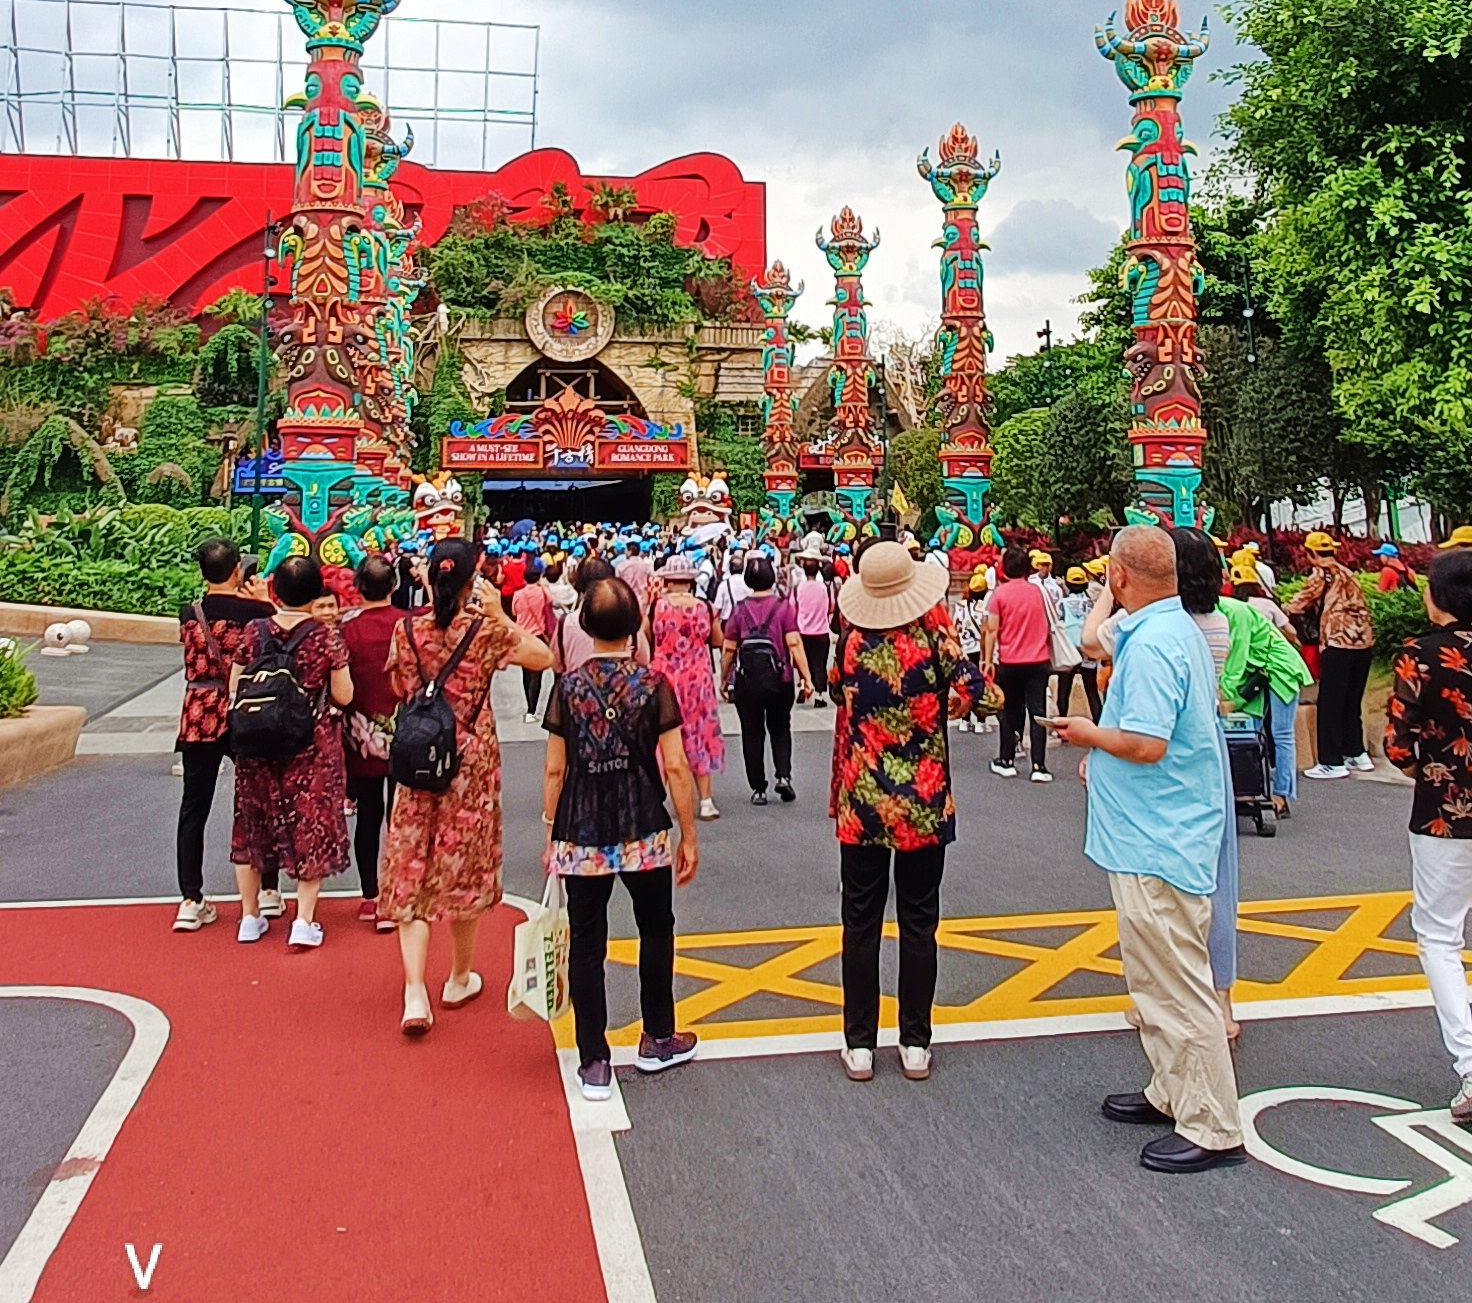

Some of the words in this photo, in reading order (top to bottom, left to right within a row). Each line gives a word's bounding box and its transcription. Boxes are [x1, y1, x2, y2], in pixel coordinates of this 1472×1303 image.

[468, 443, 476, 452] A
[476, 443, 519, 453] MUST-SEE
[617, 444, 669, 453] GUANGDONG
[450, 452, 476, 462] SHOW
[477, 452, 488, 462] IN
[488, 453, 495, 462] A
[495, 452, 536, 462] LIFETIME
[544, 442, 594, 466] 千古情
[610, 452, 652, 462] ROMANCE
[653, 452, 675, 462] PARK
